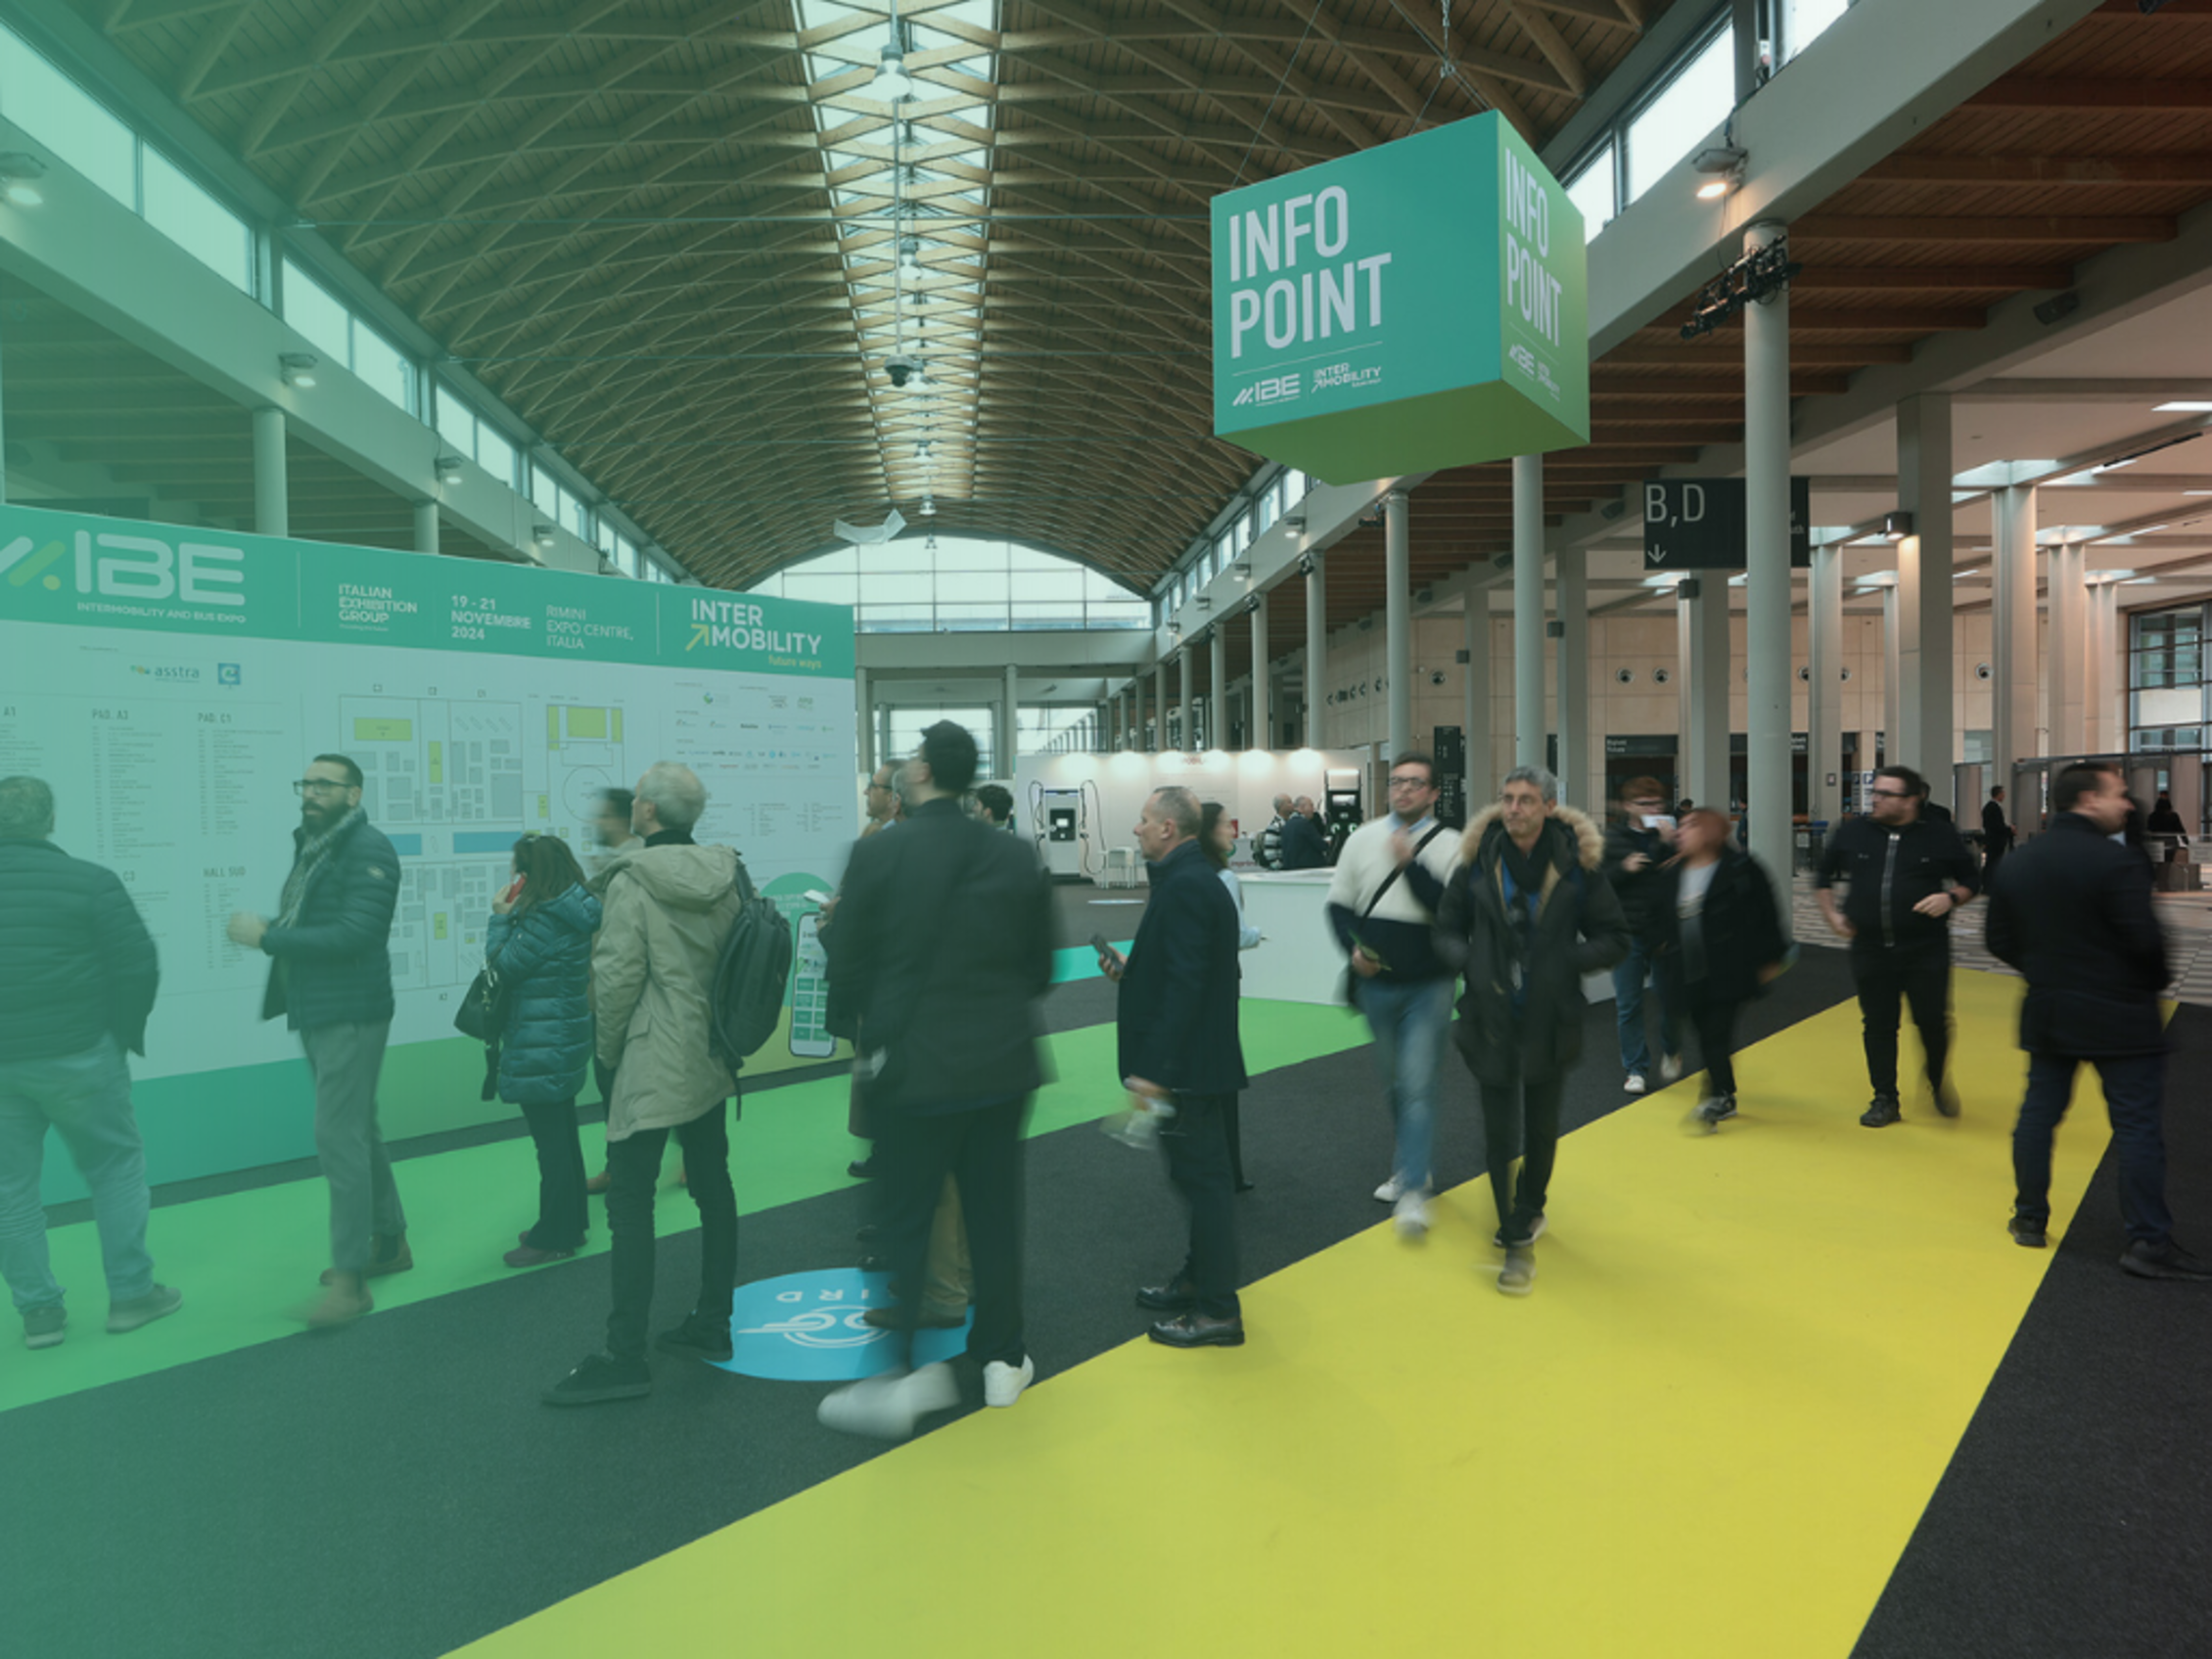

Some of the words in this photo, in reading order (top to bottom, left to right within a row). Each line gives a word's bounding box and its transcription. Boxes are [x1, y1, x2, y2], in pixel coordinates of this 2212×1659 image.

[1505, 147, 1549, 257] INFO
[1229, 185, 1349, 282] INFO
[1507, 232, 1562, 347] POINT
[1230, 252, 1393, 358] POINT
[1313, 362, 1350, 378] INTER
[1322, 366, 1382, 389] MOBILITY
[74, 530, 246, 607] IBE
[339, 583, 392, 599] ITALIAN
[339, 596, 418, 614] EXHIBITION
[450, 594, 468, 608] 19
[480, 597, 496, 611] 21
[77, 601, 165, 618] INTERMOBILITY
[166, 609, 191, 621] AND
[194, 612, 214, 622] BUS
[217, 613, 247, 623] EXPO
[339, 609, 390, 623] GROUP
[450, 610, 532, 629] NOVEMBRE
[546, 605, 587, 621] RIMINI
[691, 598, 763, 626] INTER
[450, 625, 485, 640] 2024
[546, 620, 582, 635] EXPO
[546, 634, 585, 649] ITALIA
[712, 624, 822, 655] MOBILITY
[155, 666, 200, 678] asstra
